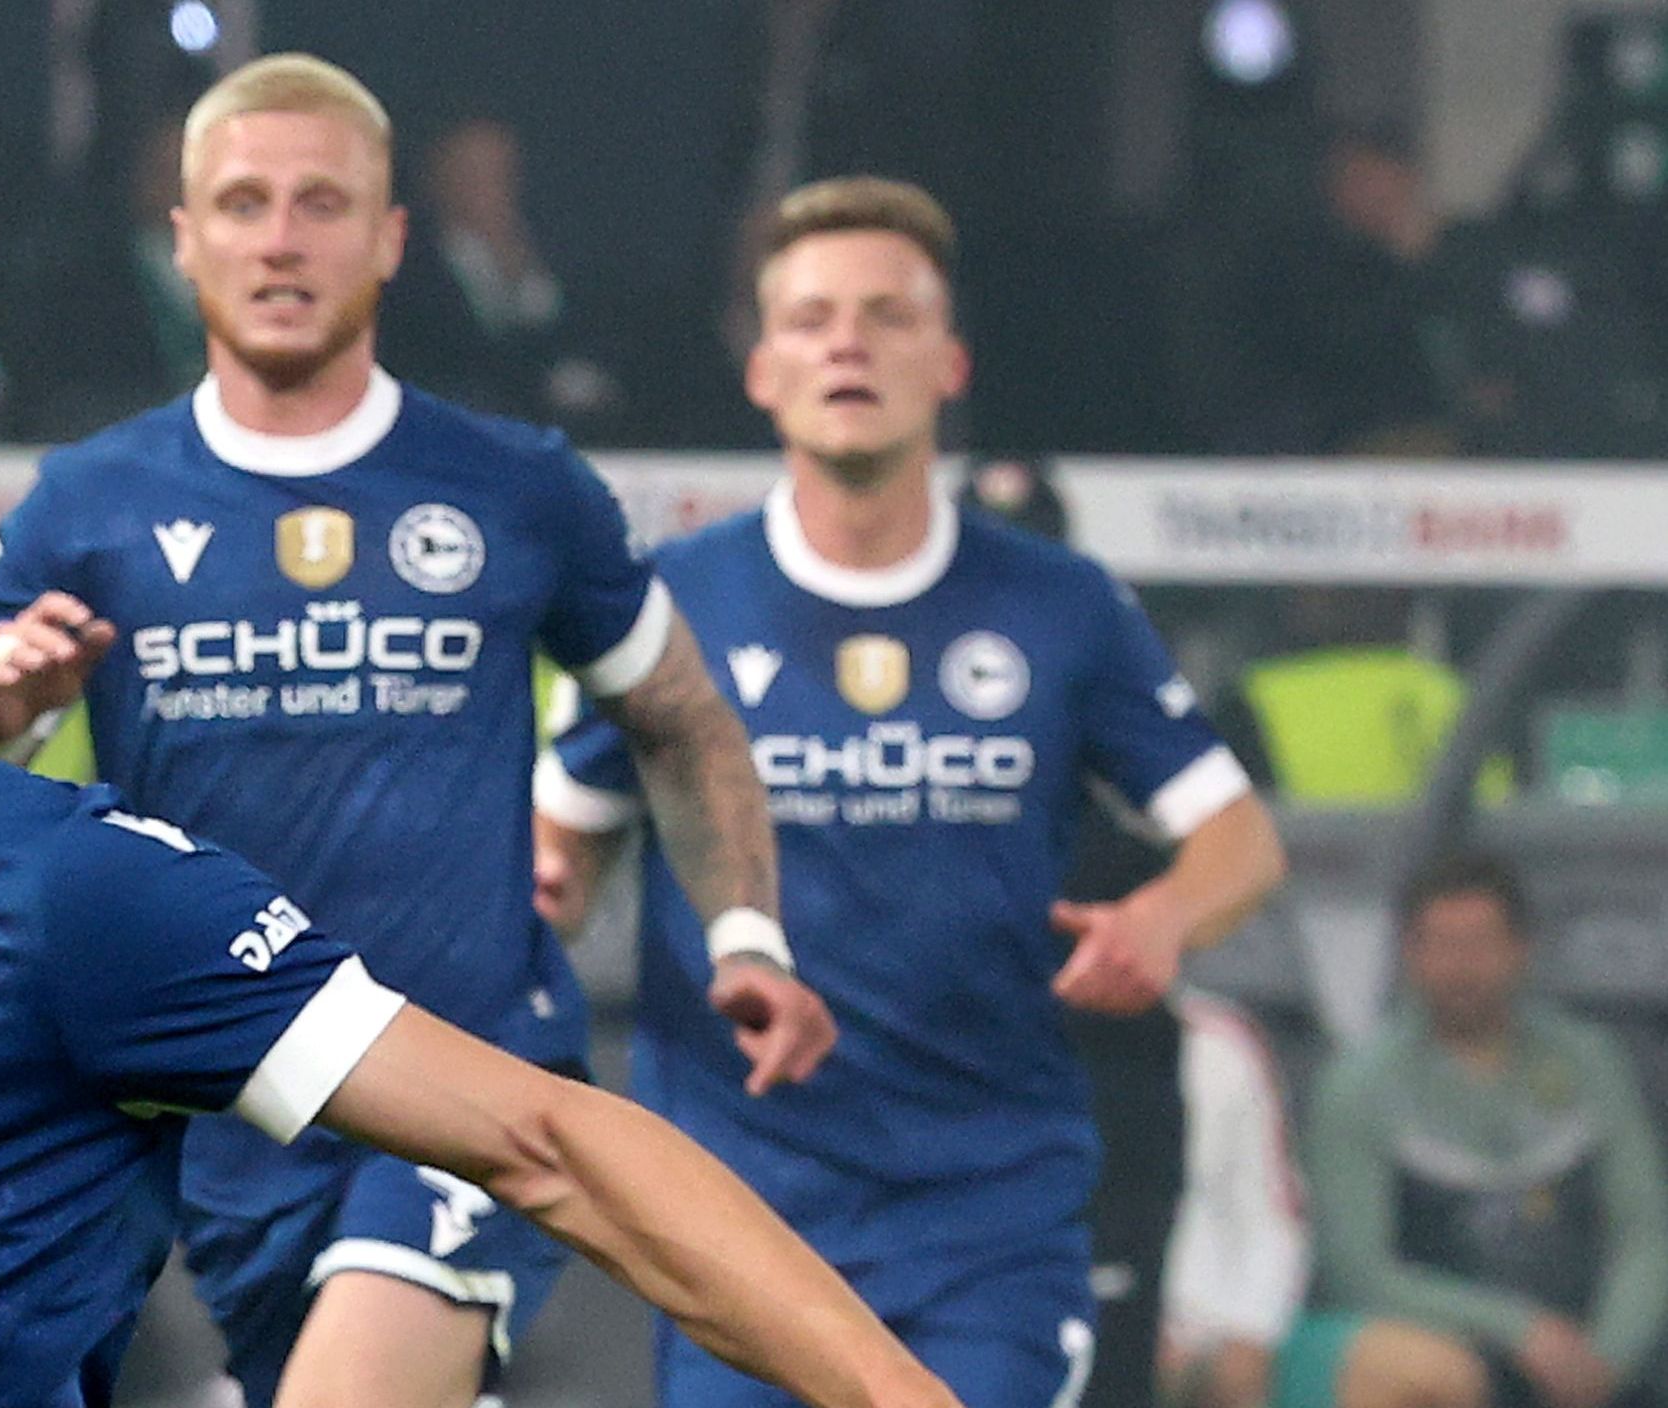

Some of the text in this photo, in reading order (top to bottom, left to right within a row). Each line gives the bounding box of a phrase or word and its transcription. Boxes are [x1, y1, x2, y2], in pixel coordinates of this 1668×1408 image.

[133, 601, 483, 680] SCHÜCO
[280, 675, 362, 716] und
[750, 721, 1036, 788] CHÜCO
